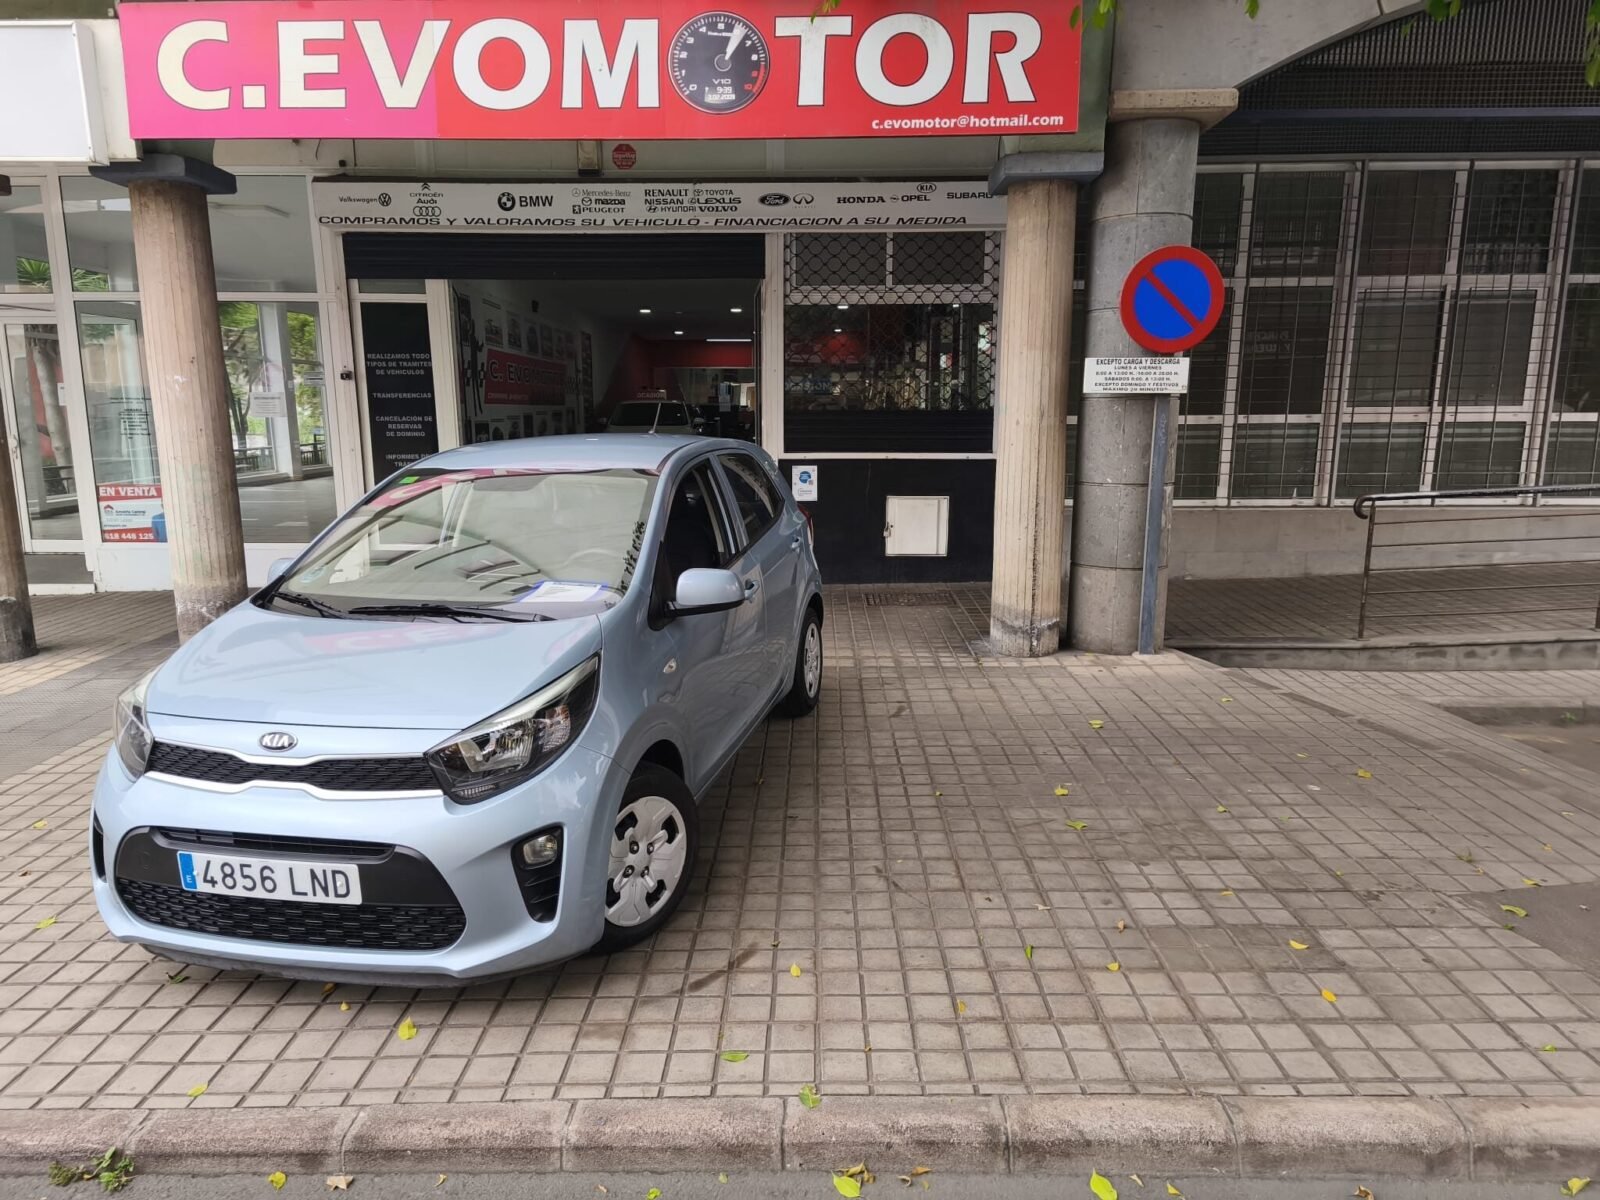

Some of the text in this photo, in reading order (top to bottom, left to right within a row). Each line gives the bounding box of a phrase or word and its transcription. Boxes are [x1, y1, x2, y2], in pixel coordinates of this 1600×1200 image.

[871, 114, 1064, 130] c.evomotor@hotmail.com
[581, 188, 631, 197] Mercedes-Benz
[644, 188, 689, 197] RENAULT
[338, 195, 378, 203] Volkswagen
[519, 195, 554, 208] BMW
[644, 198, 684, 206] NISSAN
[697, 197, 741, 205] LEXUS
[836, 196, 886, 204] HONDA
[901, 194, 930, 202] OPEL
[582, 206, 625, 214] PEUGEOT
[699, 205, 738, 213] VOLVO
[318, 216, 440, 226] COMPRAMOS
[446, 217, 457, 226] Y
[463, 217, 576, 227] VALORAMOS
[612, 218, 700, 227] VEHICULO
[713, 217, 842, 227] FINANCIACION
[847, 217, 858, 225] A
[864, 217, 889, 225] SU
[896, 216, 967, 225] MEDIDA
[99, 486, 157, 497] EN VENTA
[262, 734, 289, 748] KIA
[186, 875, 193, 883] E
[202, 860, 351, 899] 4856 LND
